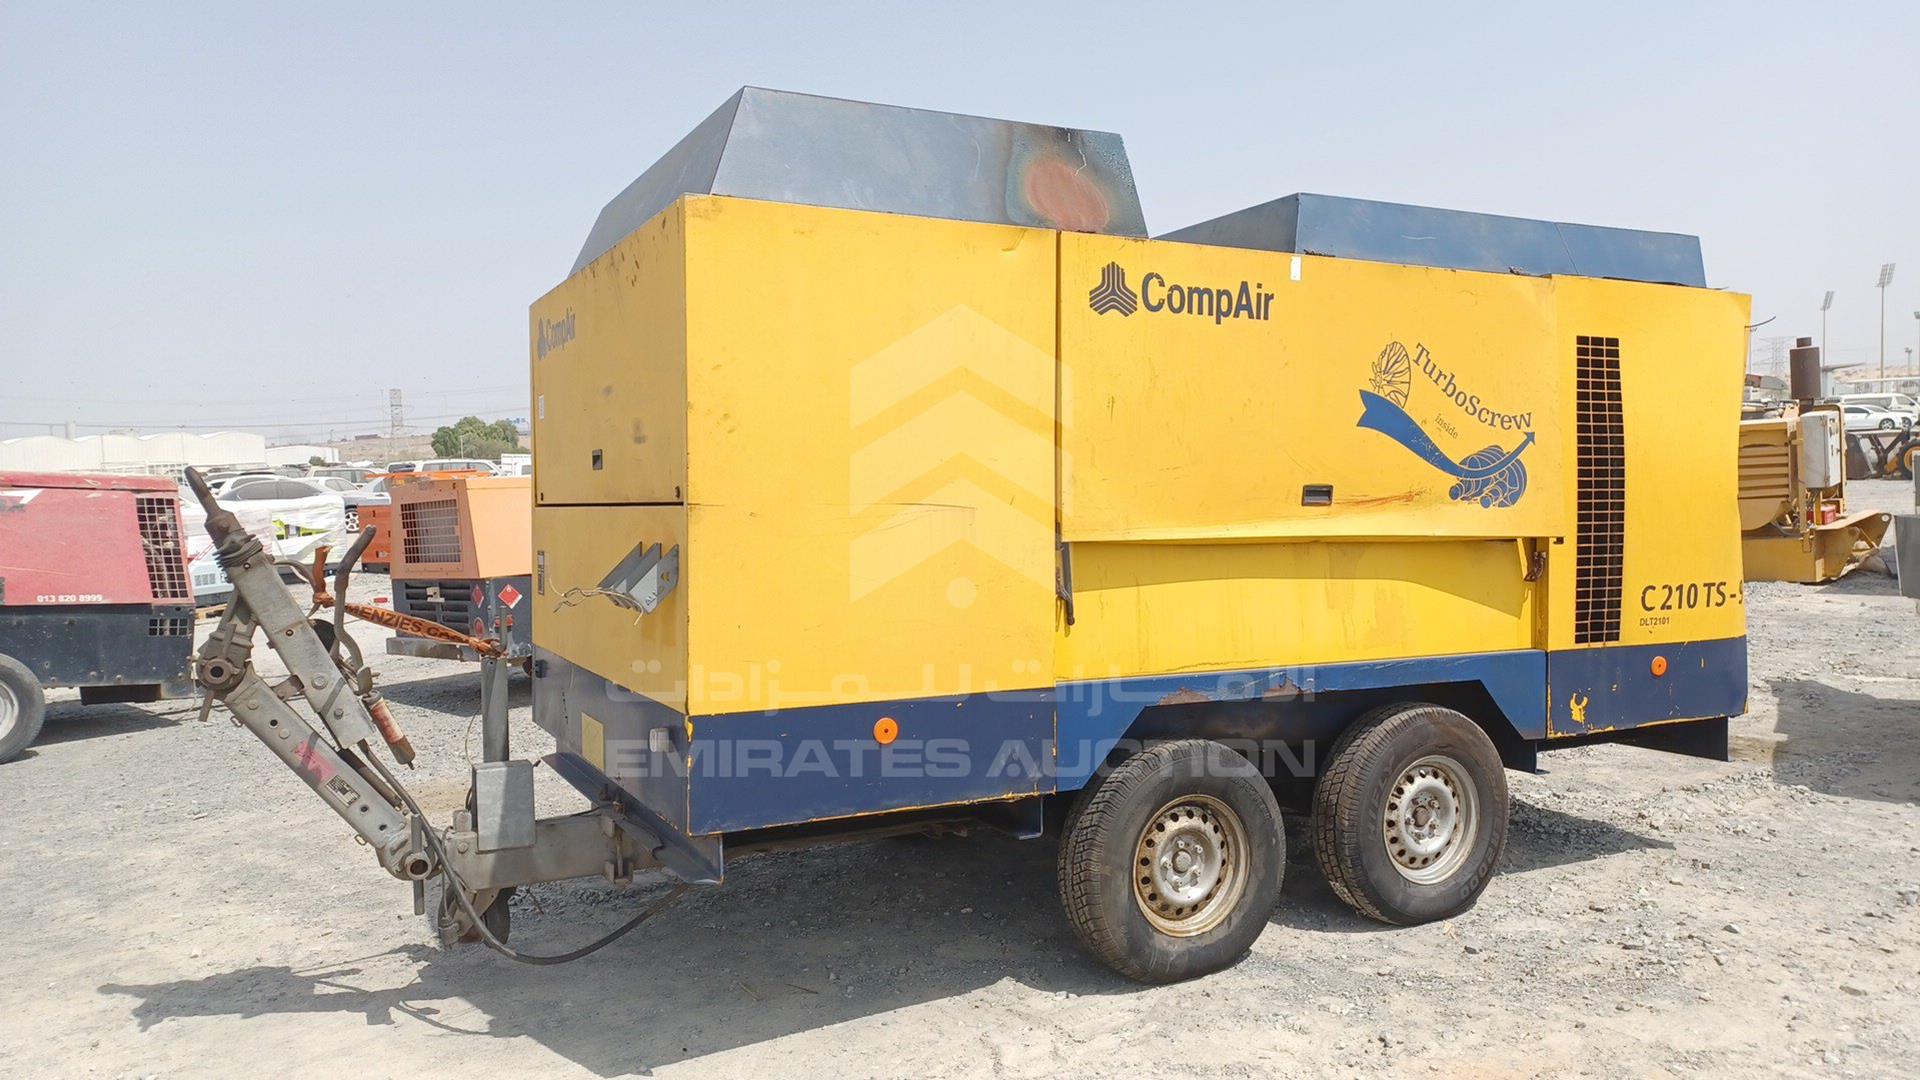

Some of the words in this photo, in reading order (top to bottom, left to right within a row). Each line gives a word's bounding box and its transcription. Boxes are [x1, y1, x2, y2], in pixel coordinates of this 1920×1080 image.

[1141, 272, 1275, 325] CompAir
[1412, 342, 1532, 431] TurboScrew
[1434, 412, 1458, 440] inside
[36, 594, 56, 603] 013
[1640, 584, 1656, 612] C
[1660, 583, 1698, 611] 210
